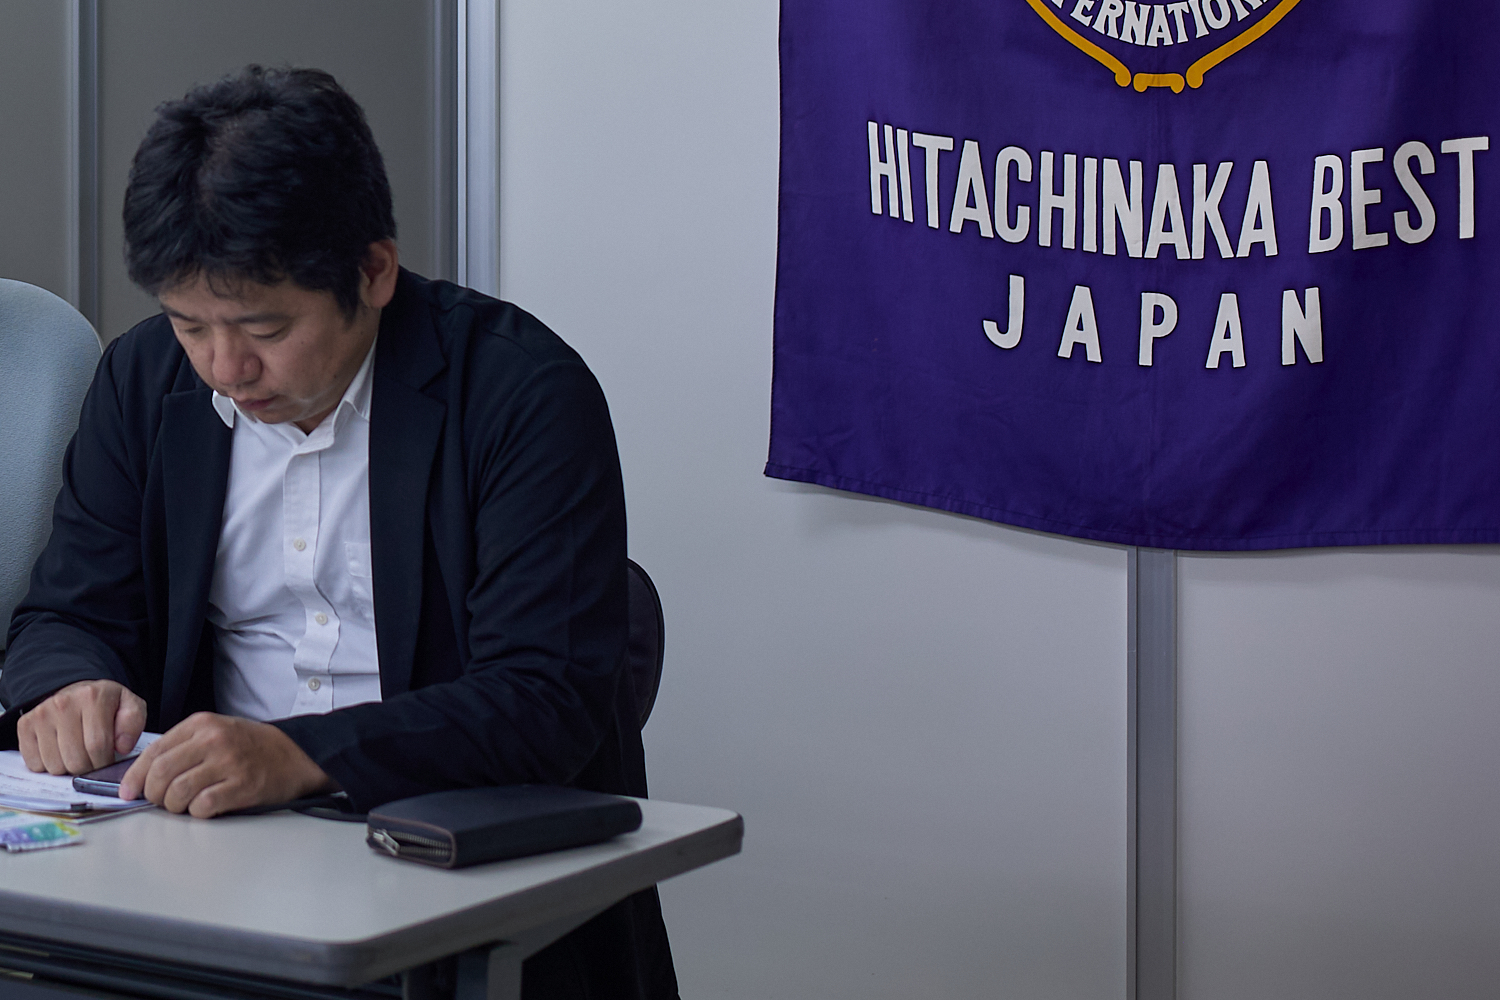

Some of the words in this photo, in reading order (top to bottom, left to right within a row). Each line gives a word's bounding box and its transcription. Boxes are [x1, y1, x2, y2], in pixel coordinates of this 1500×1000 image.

[867, 121, 1279, 260] HITACHINAKA
[1308, 136, 1490, 254] BEST
[982, 274, 1324, 369] JAPAN
